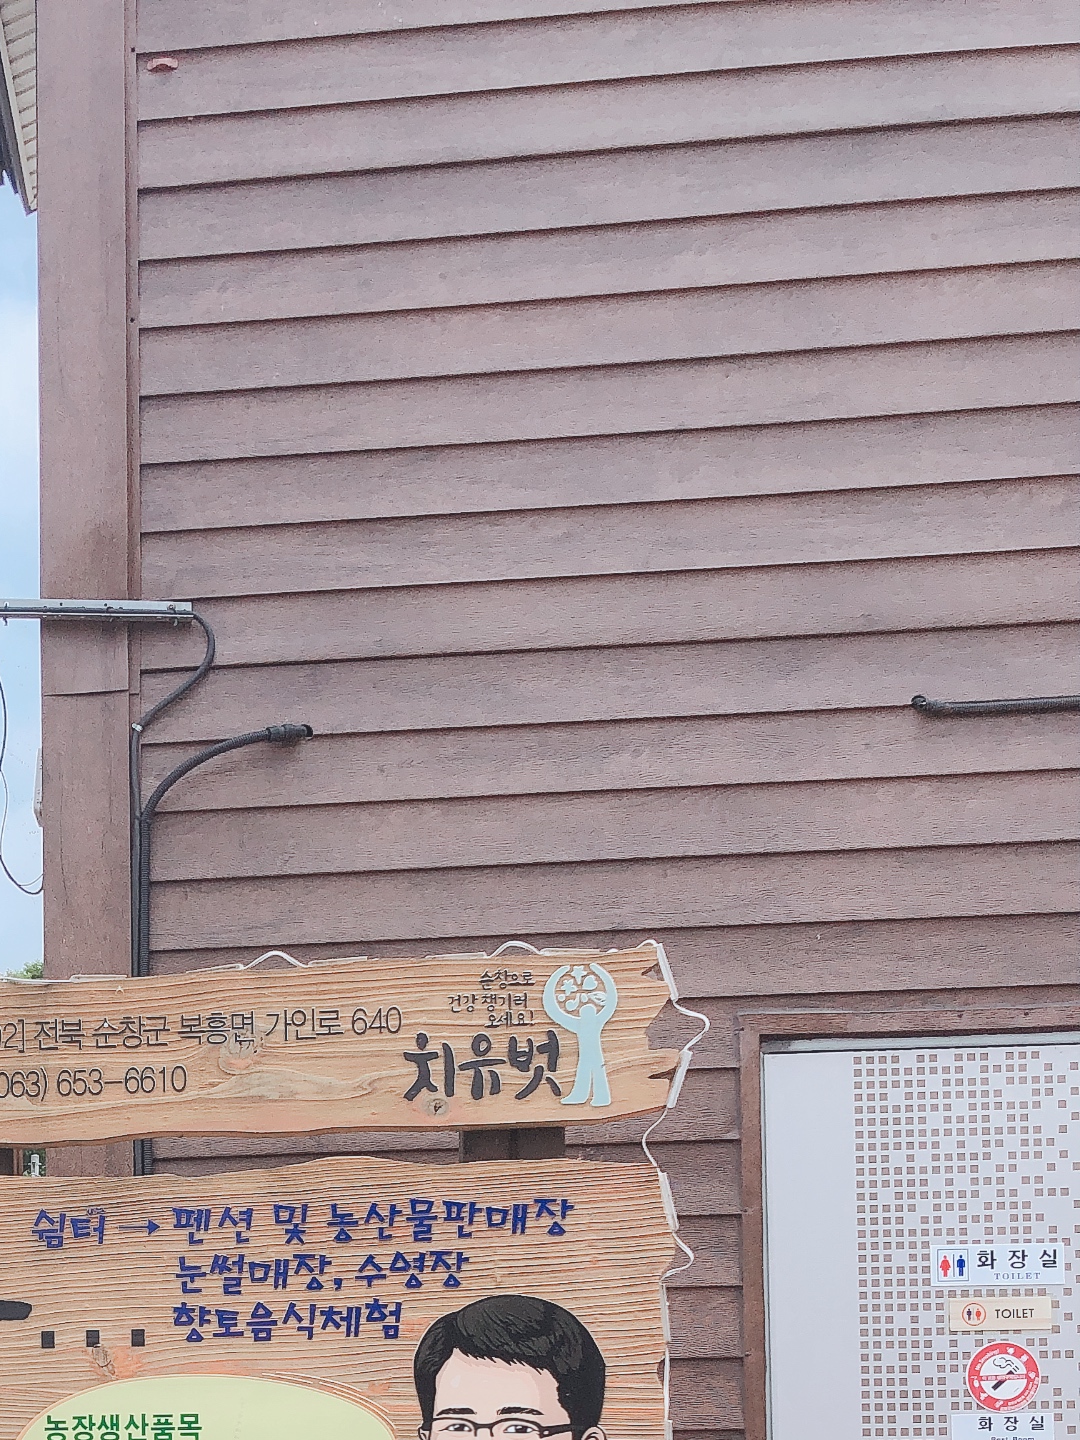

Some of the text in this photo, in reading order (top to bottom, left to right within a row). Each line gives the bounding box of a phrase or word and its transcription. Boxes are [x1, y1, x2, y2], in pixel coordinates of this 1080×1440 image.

[447, 992, 478, 1012] 건강
[33, 1018, 86, 1051] 전북
[92, 1015, 170, 1049] 순창군
[265, 1006, 345, 1042] 가인로
[351, 1006, 402, 1035] 640
[57, 1064, 188, 1097] 653-6610
[31, 1197, 575, 1249] 쉼터 펜션 및 농산물판매장
[994, 1272, 1041, 1280] TOILET
[172, 1298, 403, 1343] 향토음식체험
[994, 1308, 1035, 1319] TOILET
